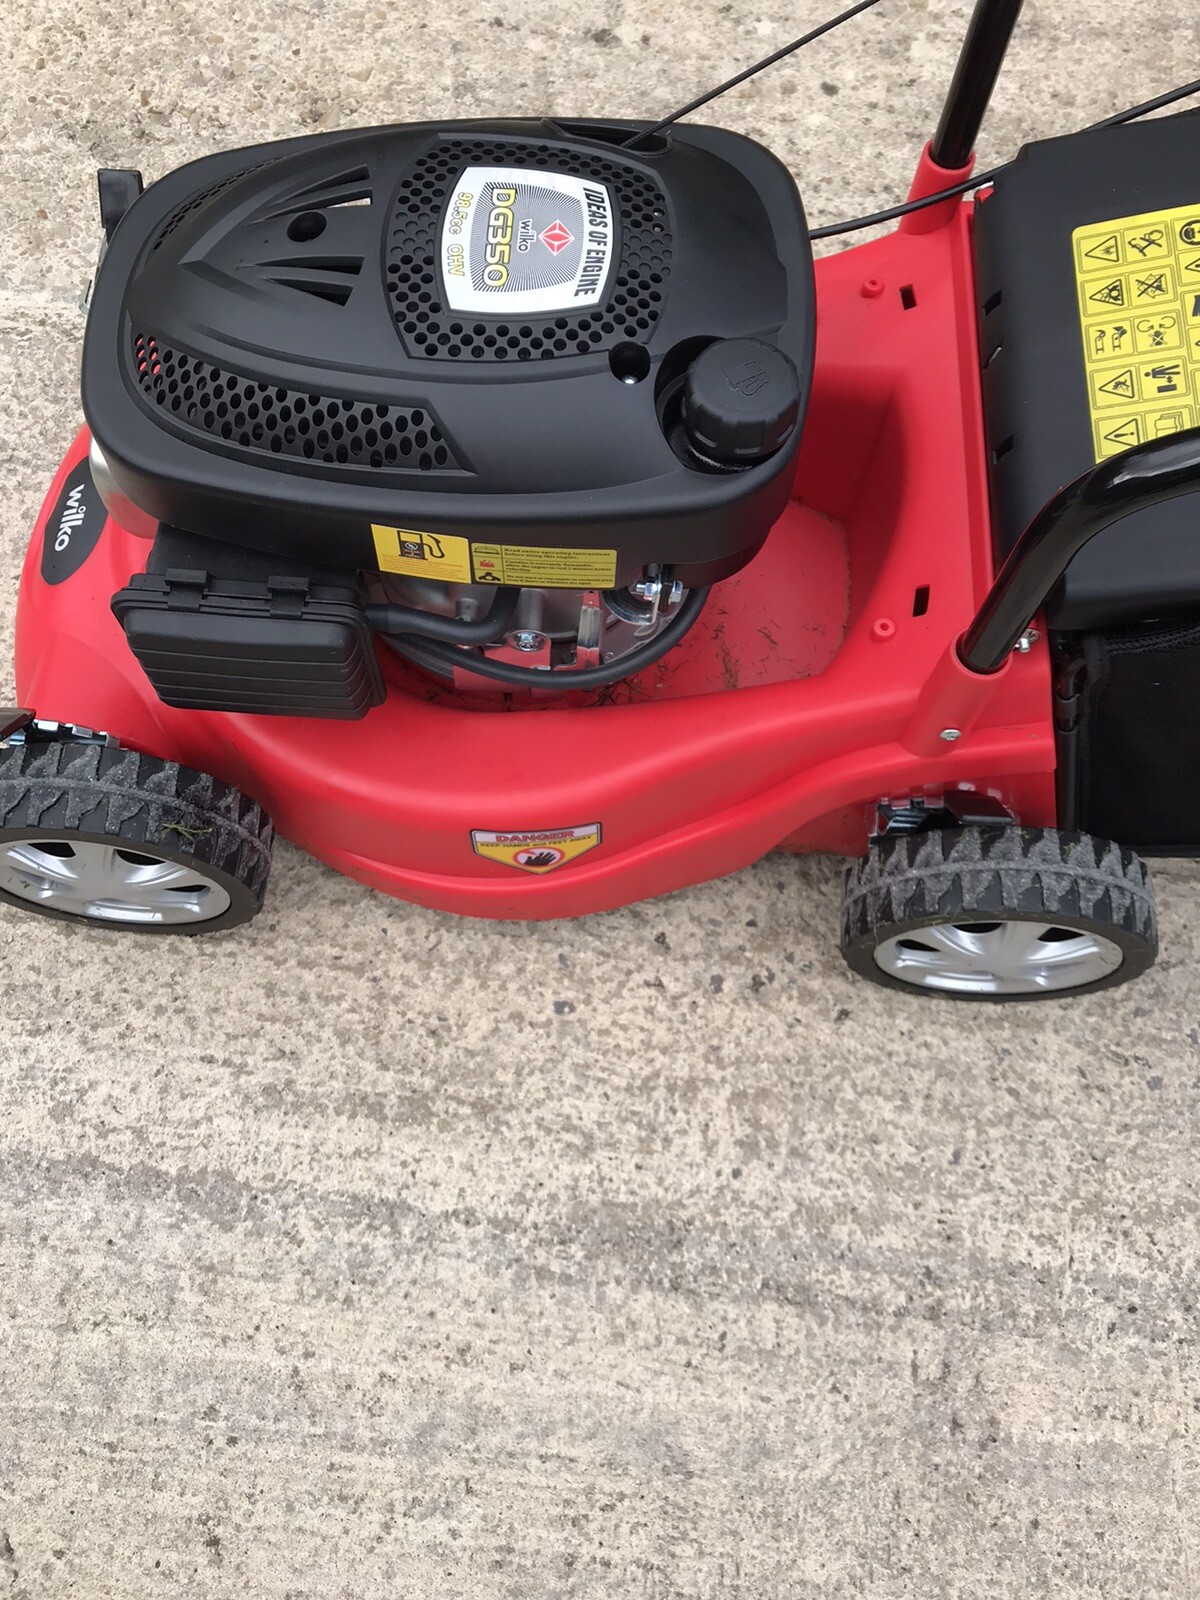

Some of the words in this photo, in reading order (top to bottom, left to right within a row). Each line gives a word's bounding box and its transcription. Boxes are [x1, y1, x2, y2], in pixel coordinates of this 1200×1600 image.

[449, 192, 474, 235] 98.5cc
[583, 187, 608, 229] IDEAS
[483, 187, 518, 288] DG350
[517, 219, 535, 252] wilko
[588, 231, 608, 247] OF
[447, 243, 465, 277] OHV
[574, 248, 606, 297] ENGINE
[54, 483, 87, 552] wilko
[495, 831, 576, 843] DANGER
[569, 835, 592, 843] AWAY
